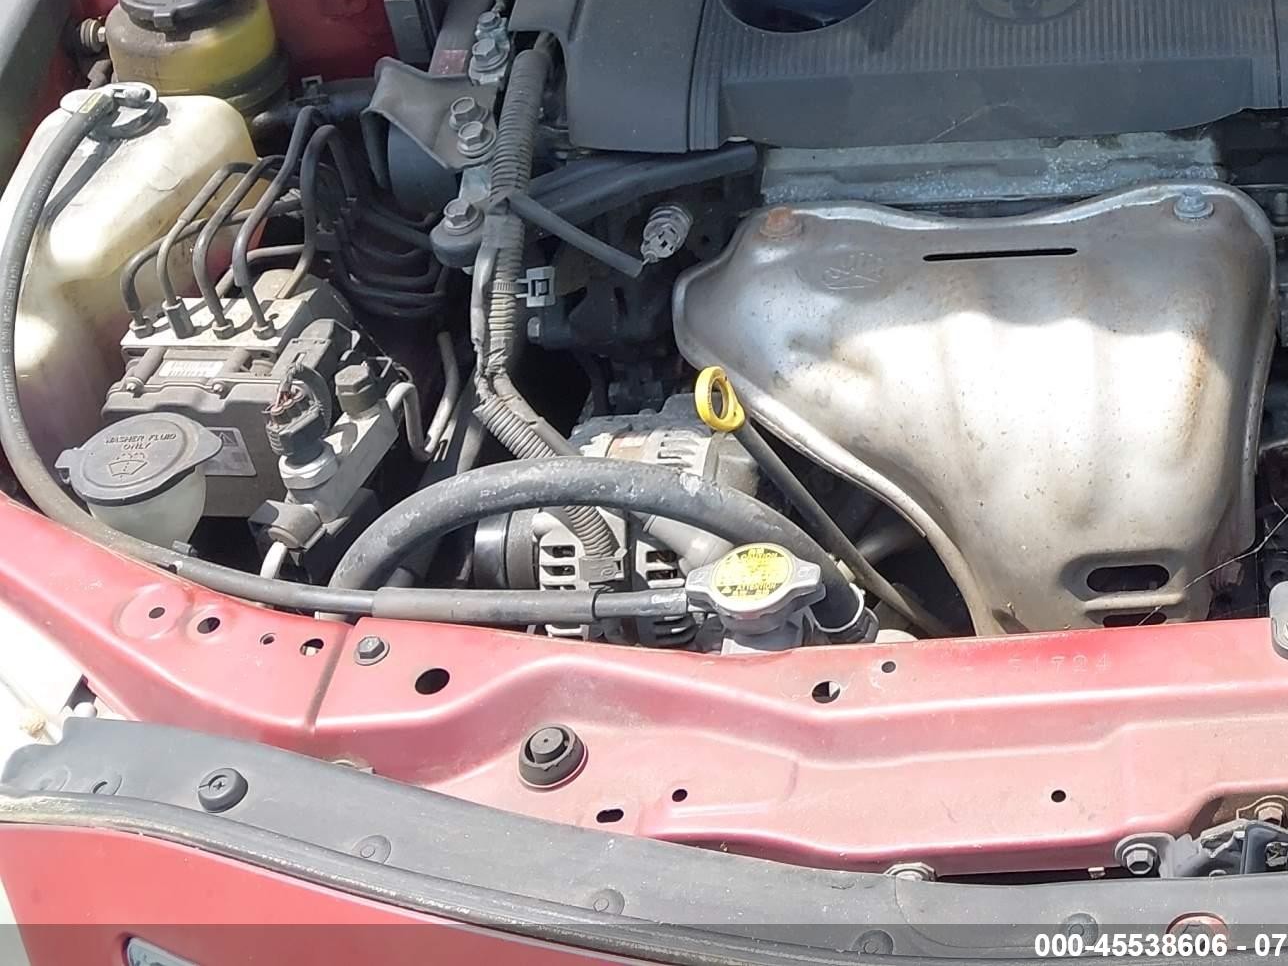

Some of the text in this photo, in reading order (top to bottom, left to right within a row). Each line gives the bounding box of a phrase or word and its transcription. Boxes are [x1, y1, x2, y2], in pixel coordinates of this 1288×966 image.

[105, 433, 177, 444] WASHER FLUID
[123, 442, 152, 451] ONLY
[740, 551, 778, 561] CAUTION
